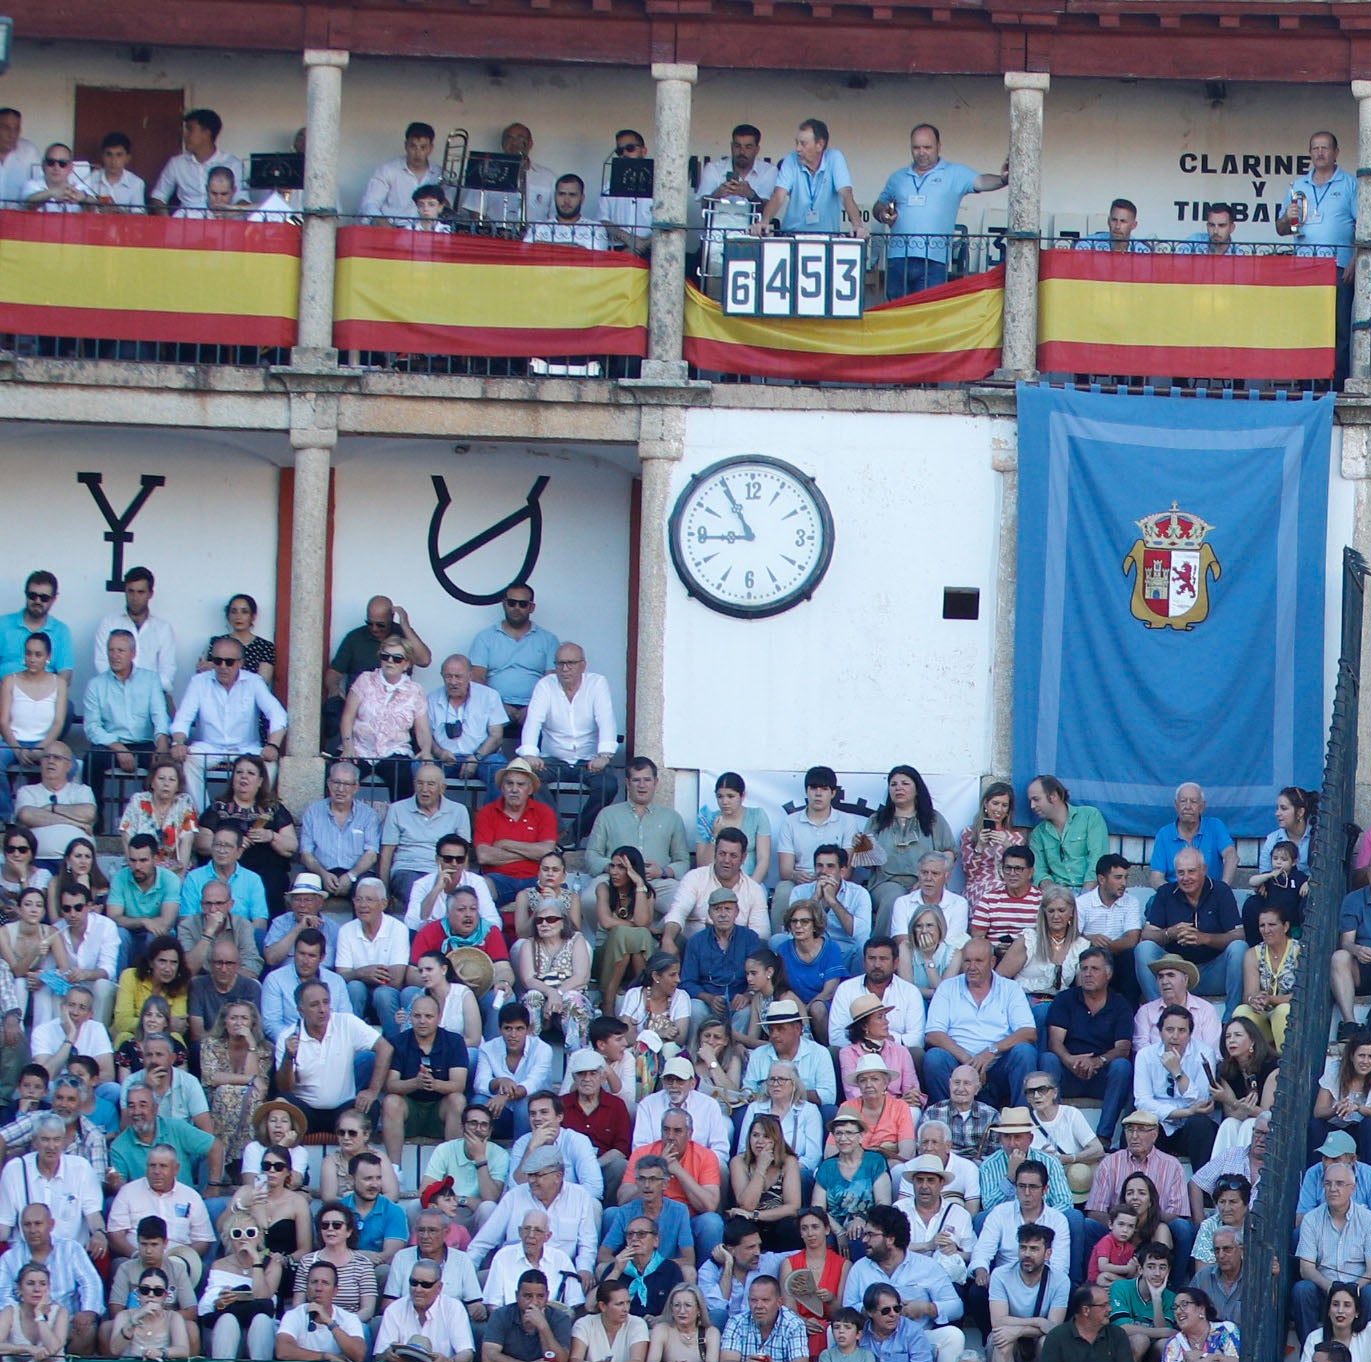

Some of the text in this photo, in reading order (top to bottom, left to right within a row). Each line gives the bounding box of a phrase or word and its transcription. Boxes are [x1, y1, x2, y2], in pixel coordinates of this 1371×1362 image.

[1179, 153, 1312, 178] CLARINE
[1251, 181, 1267, 198] Y
[745, 482, 762, 500] 12
[795, 529, 806, 547] 3
[744, 570, 755, 589] 6
